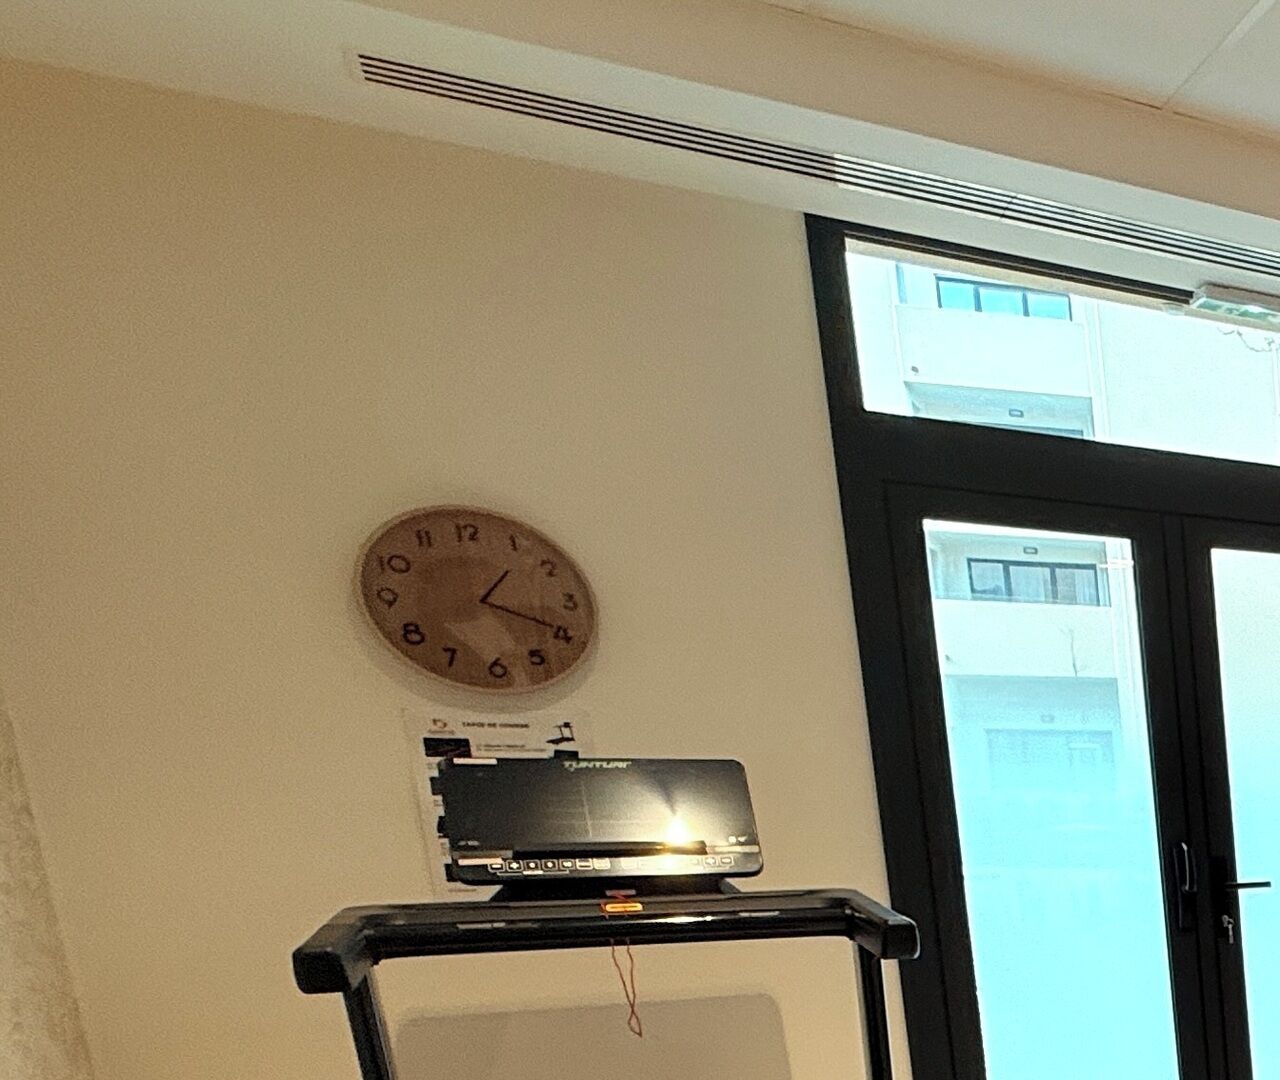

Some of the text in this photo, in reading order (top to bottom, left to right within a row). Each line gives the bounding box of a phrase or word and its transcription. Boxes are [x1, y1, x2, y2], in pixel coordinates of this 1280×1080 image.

[415, 529, 432, 548] 11
[454, 523, 479, 543] 12
[508, 534, 518, 551] 1
[377, 555, 411, 574] 10
[540, 558, 557, 577] 2
[376, 586, 399, 610] 9
[562, 592, 578, 612] 3
[402, 622, 426, 646] 8
[552, 624, 573, 644] 4
[441, 646, 458, 668] 7
[527, 648, 546, 666] 5
[488, 657, 508, 679] 6
